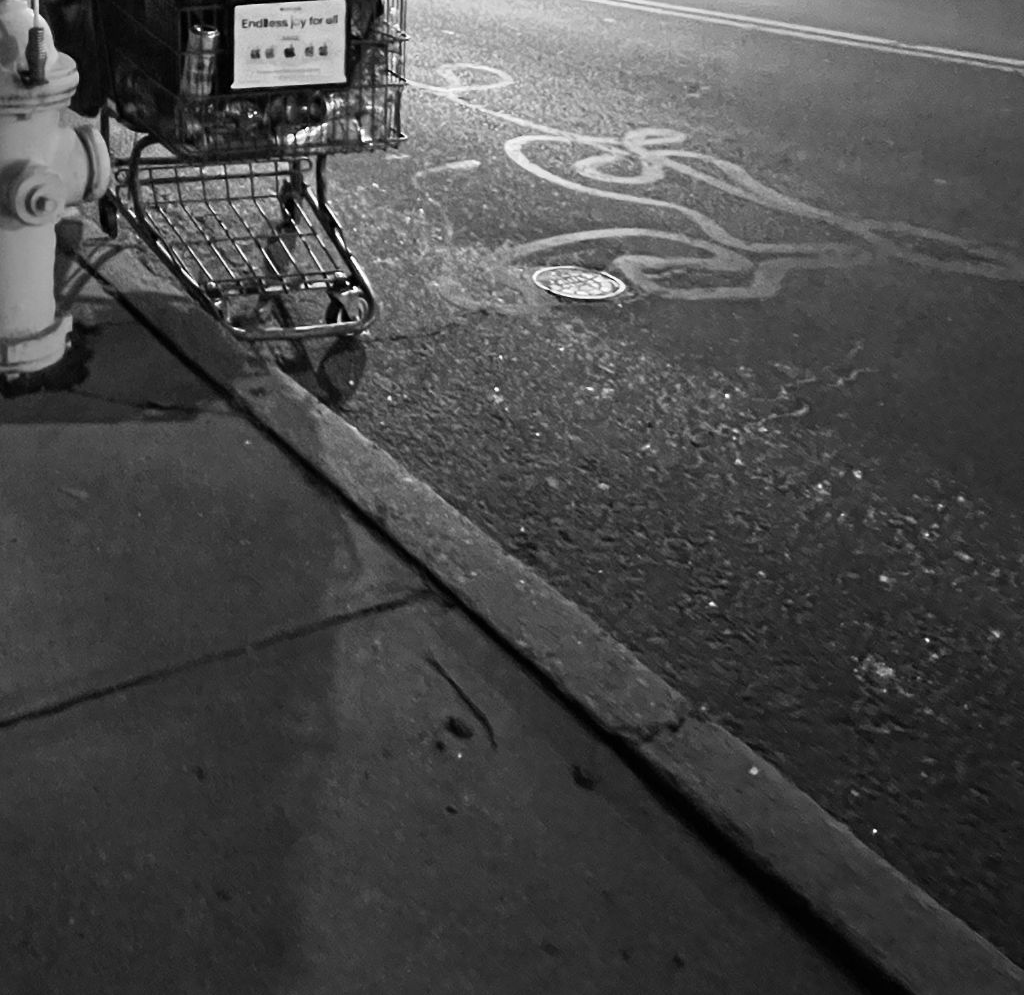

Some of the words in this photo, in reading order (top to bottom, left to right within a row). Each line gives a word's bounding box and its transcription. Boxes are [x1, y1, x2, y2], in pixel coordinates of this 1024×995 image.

[241, 18, 289, 29] Endless
[309, 16, 324, 26] for
[325, 14, 339, 25] all
